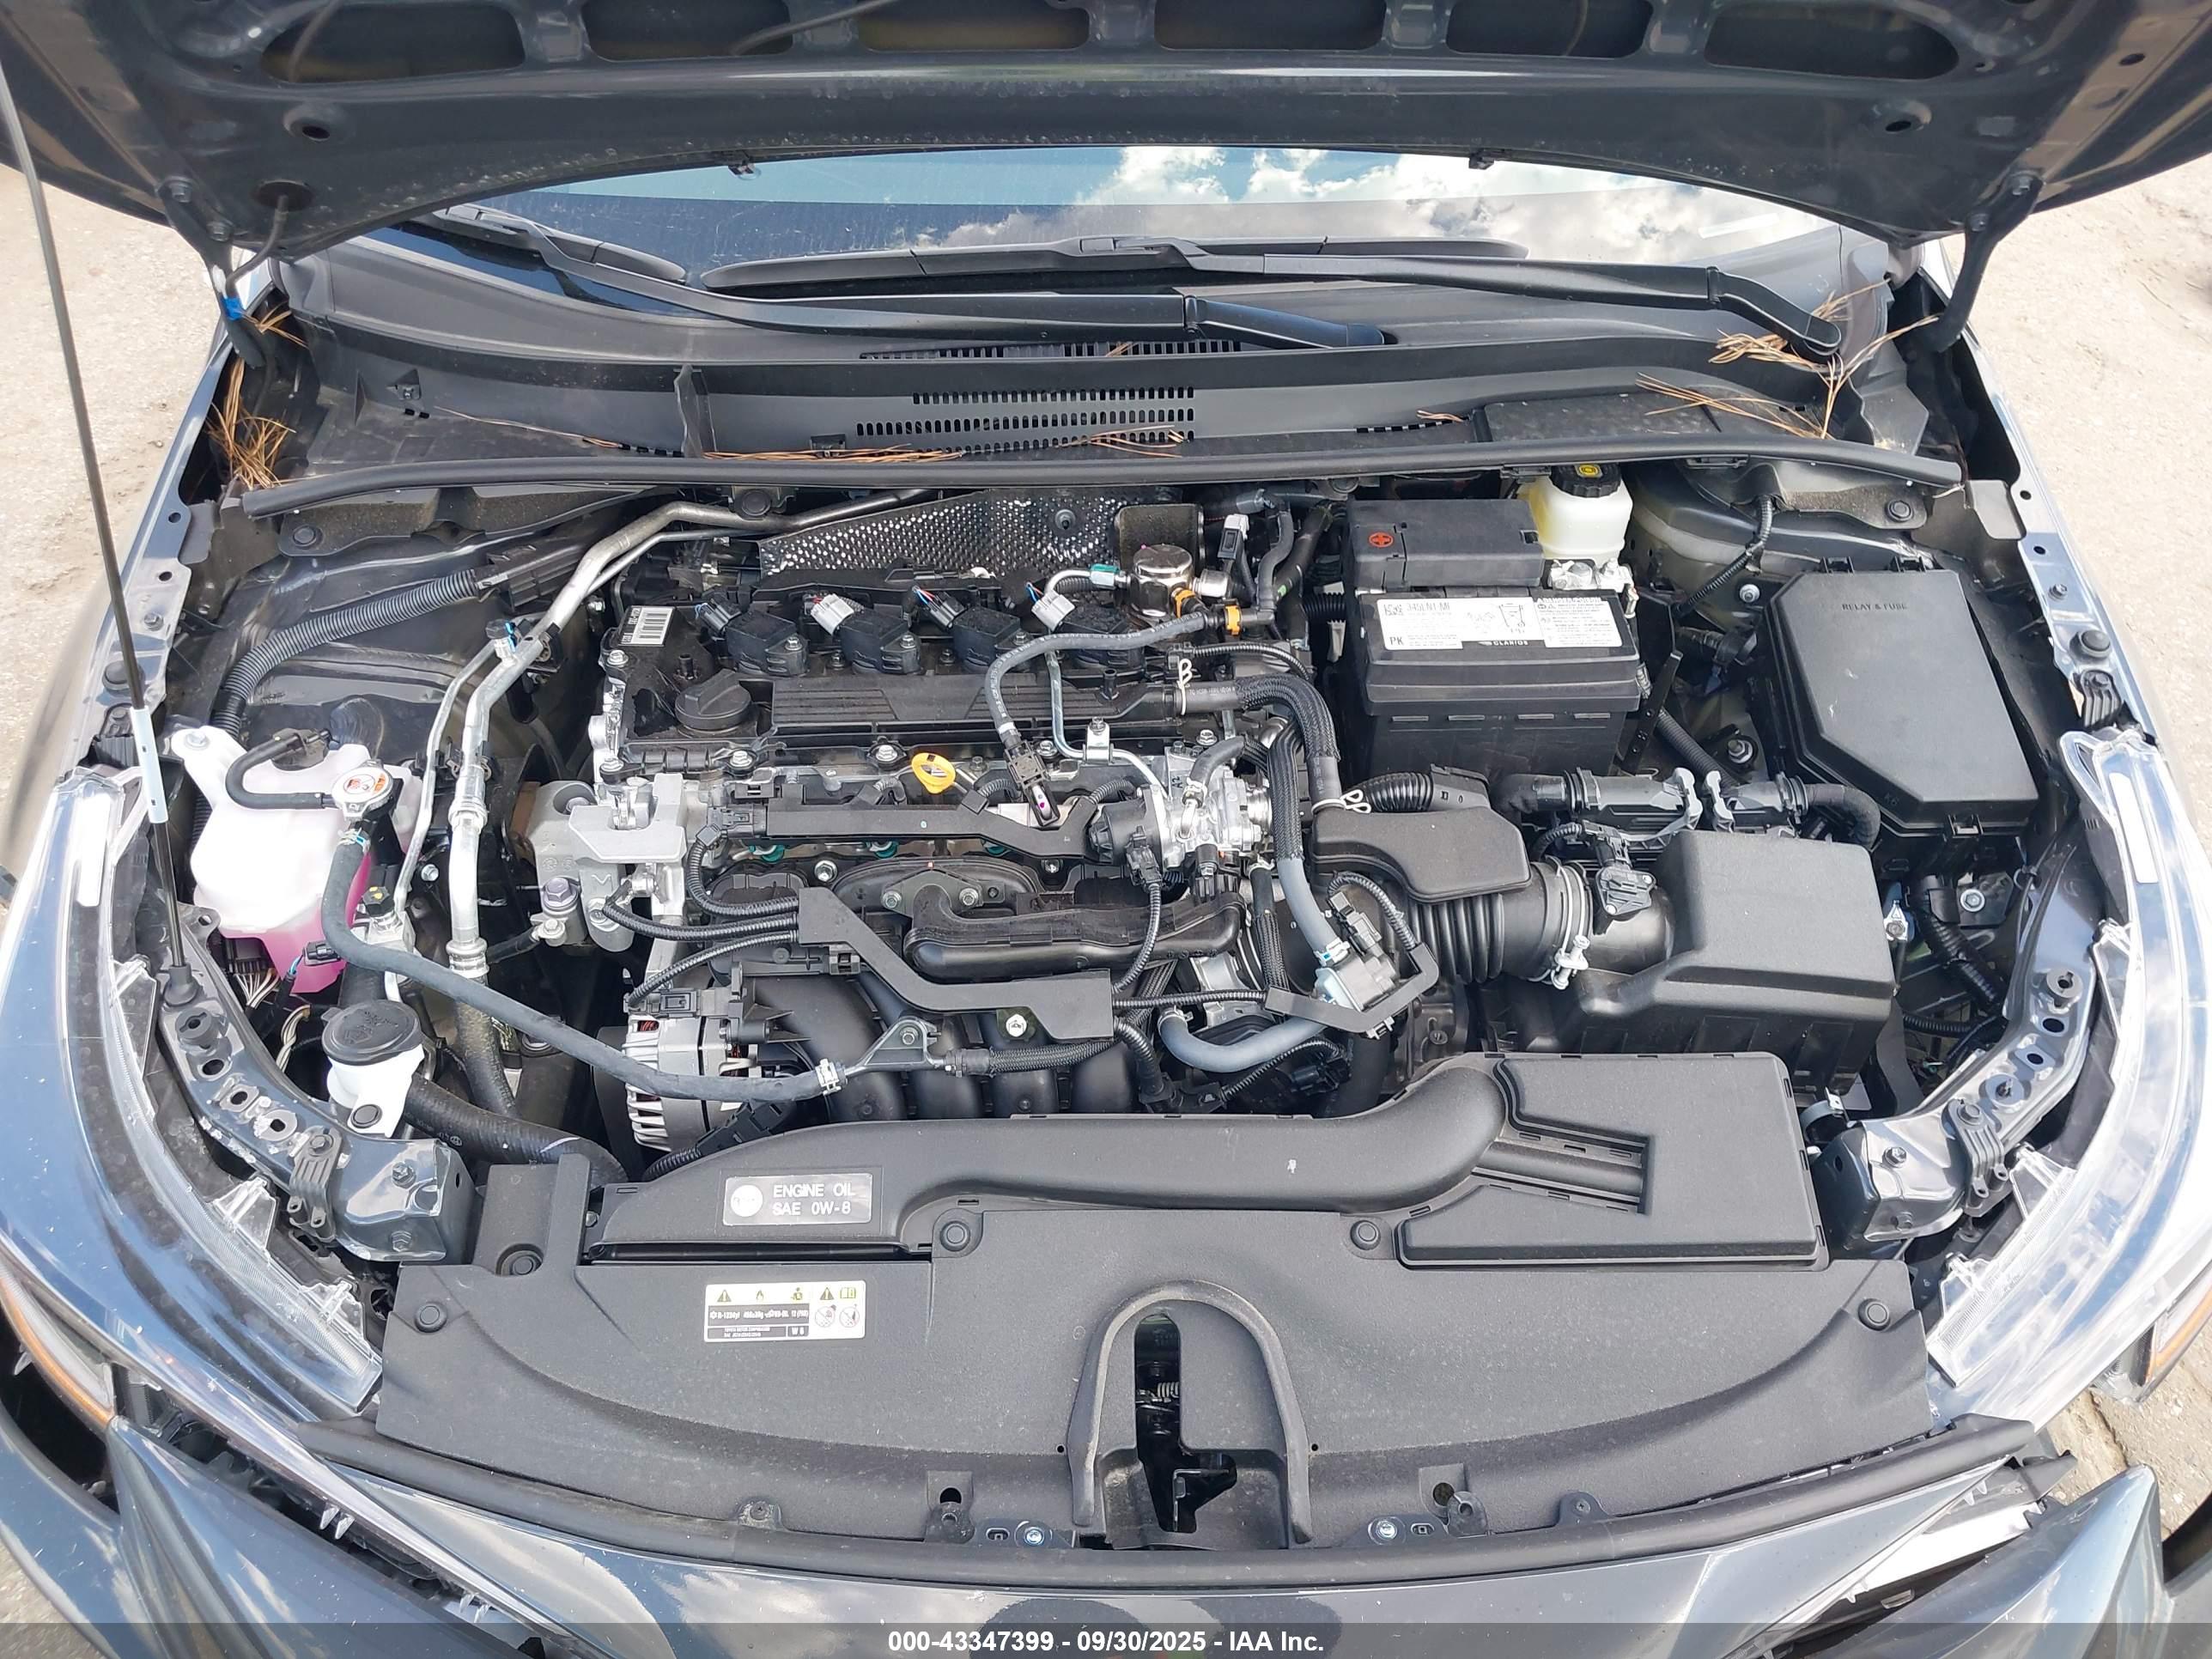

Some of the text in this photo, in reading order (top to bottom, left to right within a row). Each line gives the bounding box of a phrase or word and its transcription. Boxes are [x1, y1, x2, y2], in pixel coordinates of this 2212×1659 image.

[773, 1182, 856, 1198] ENGINE OIL
[772, 1200, 851, 1216] SAE 0W-8
